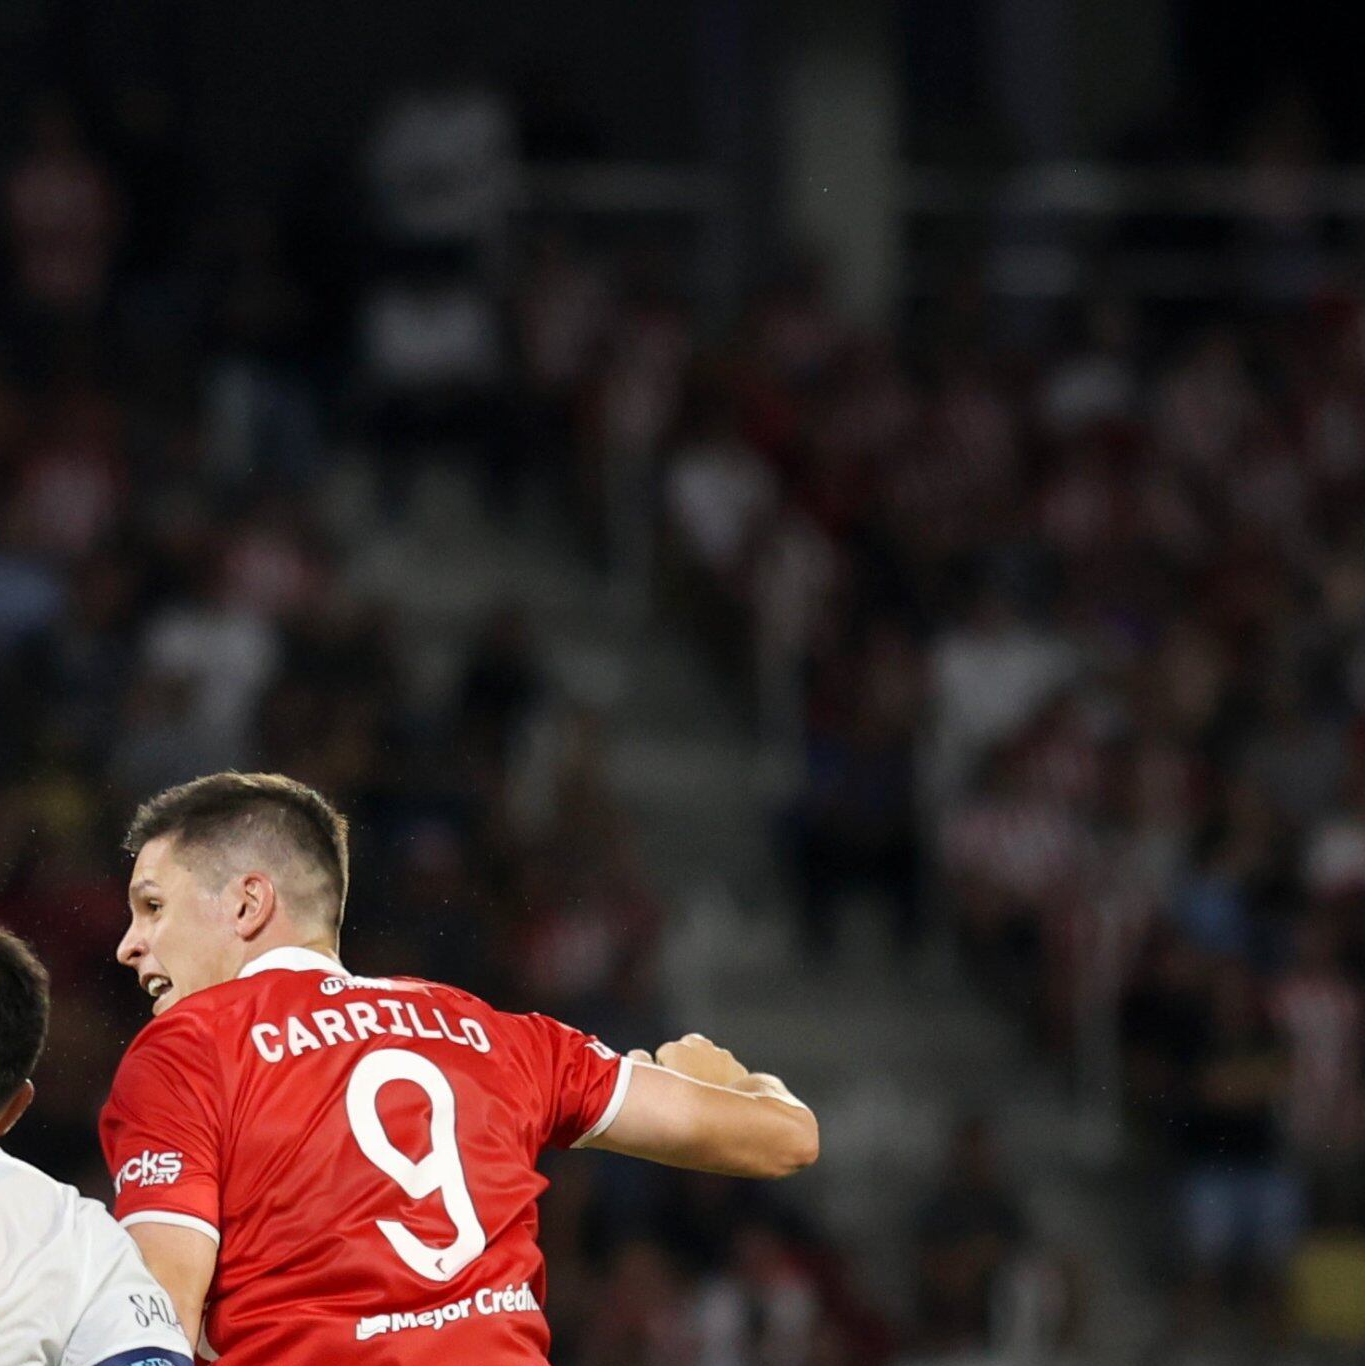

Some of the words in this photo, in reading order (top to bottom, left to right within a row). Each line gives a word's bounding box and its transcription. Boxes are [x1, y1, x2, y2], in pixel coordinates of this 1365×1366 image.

[251, 999, 491, 1063] CARRILLO
[345, 1048, 487, 1282] 9
[391, 1297, 472, 1331] Mejor
